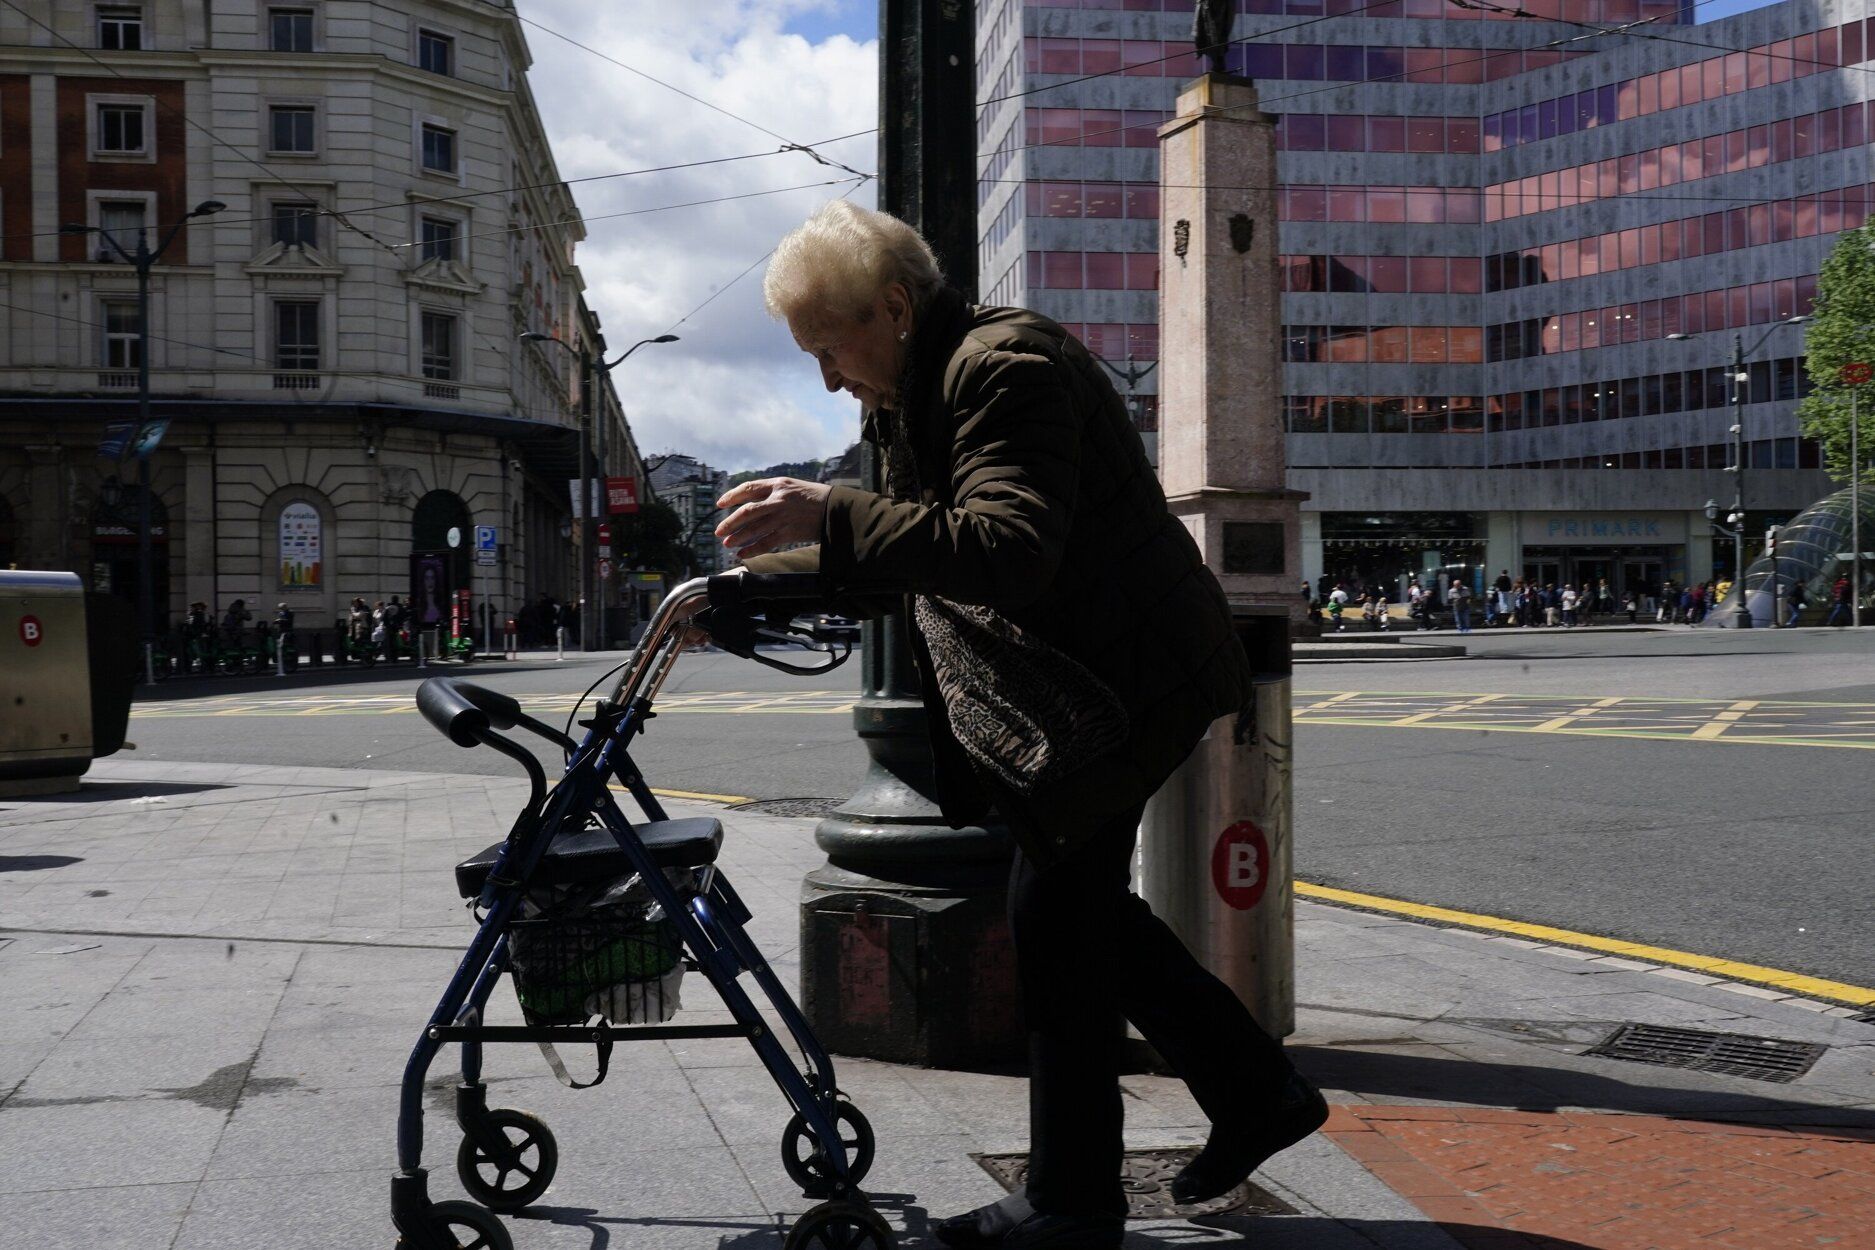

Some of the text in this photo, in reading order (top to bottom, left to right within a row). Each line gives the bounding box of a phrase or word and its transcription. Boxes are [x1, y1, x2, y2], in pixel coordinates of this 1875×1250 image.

[1547, 518, 1661, 537] PRIMARK
[480, 528, 492, 549] P
[24, 622, 39, 640] B
[1228, 842, 1260, 888] B
